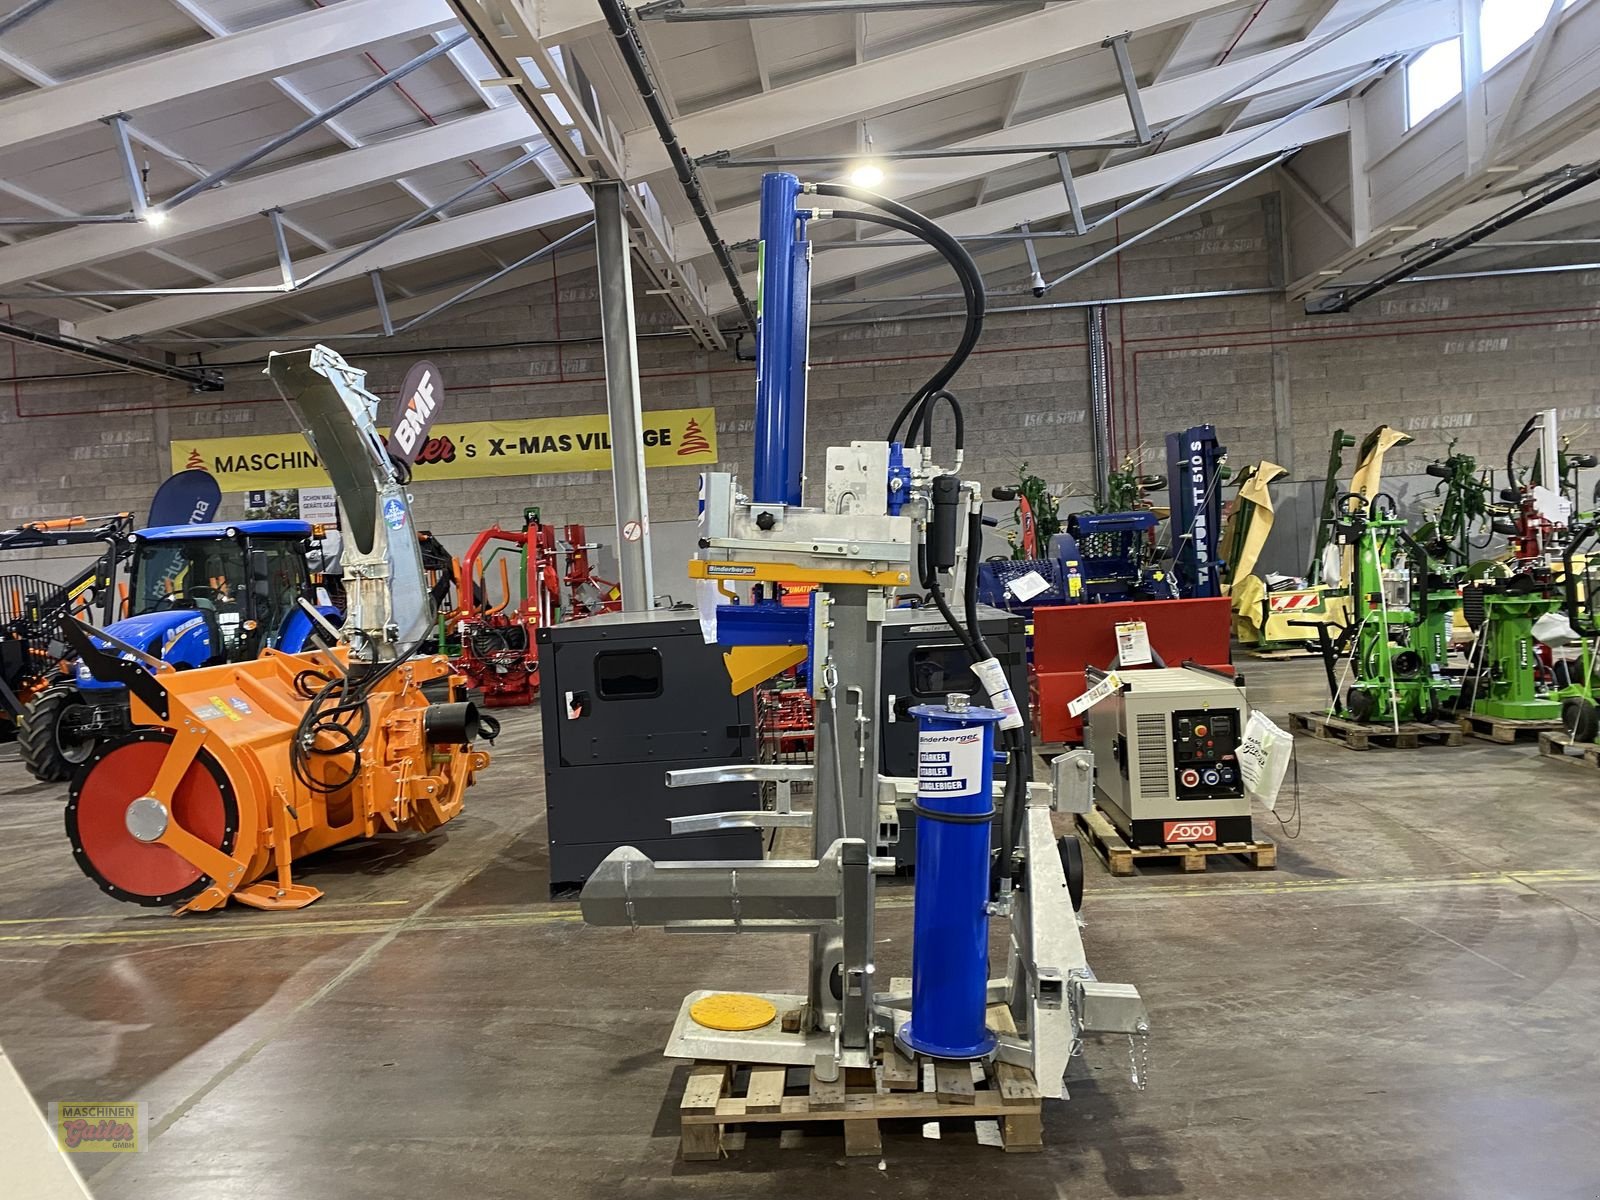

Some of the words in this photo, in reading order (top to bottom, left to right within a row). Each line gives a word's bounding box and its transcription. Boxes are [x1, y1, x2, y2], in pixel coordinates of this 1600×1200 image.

[394, 370, 436, 455] BMF
[1440, 413, 1472, 428] SPAN
[215, 450, 328, 473] MASCHIN
[488, 435, 572, 457] X-MAS
[576, 428, 671, 451] VILGE
[1190, 440, 1202, 451] S
[1192, 455, 1204, 484] 510
[1193, 487, 1205, 507] TT
[708, 565, 755, 574] Binderberger
